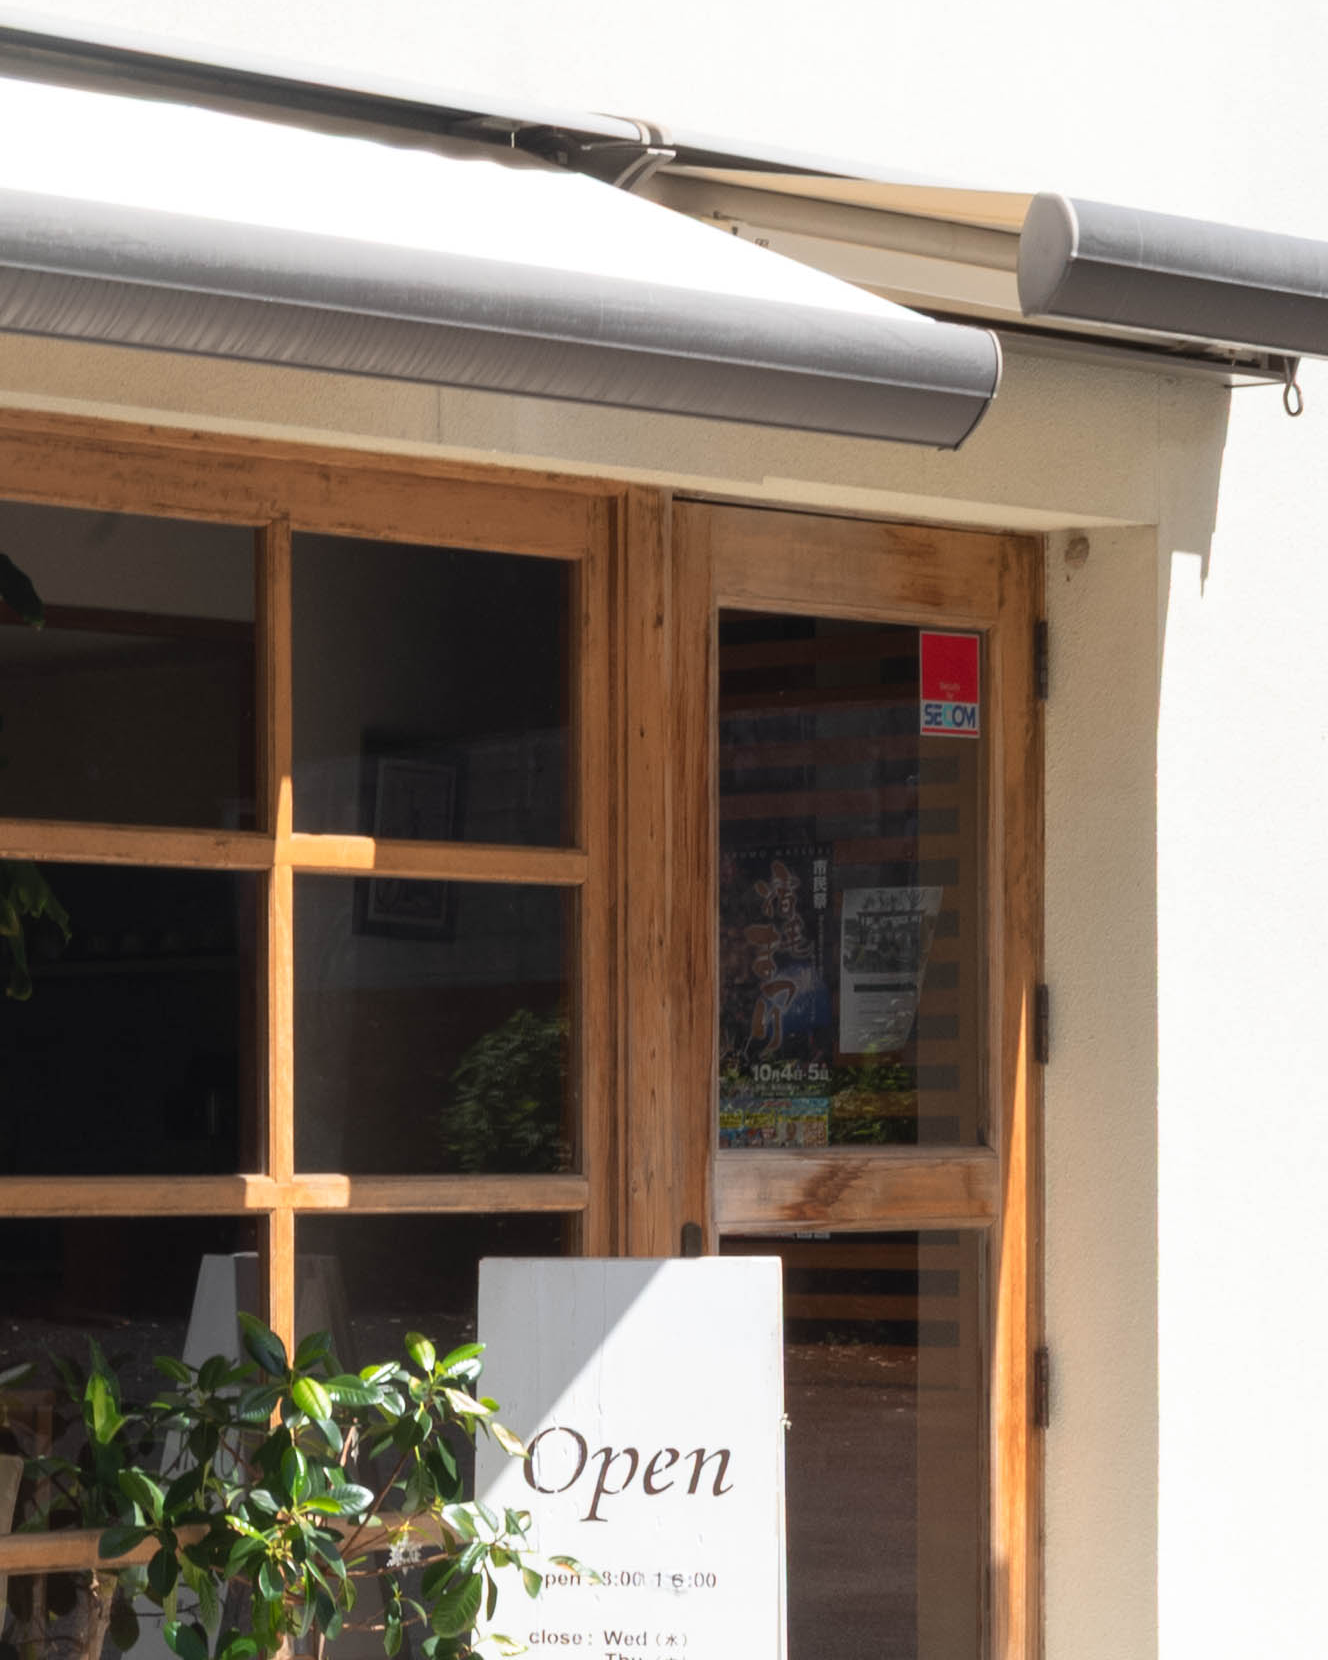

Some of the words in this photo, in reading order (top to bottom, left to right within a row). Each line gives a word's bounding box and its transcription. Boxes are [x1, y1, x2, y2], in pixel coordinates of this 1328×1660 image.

[924, 703, 976, 728] SECOM
[522, 1425, 735, 1523] Open
[603, 1629, 648, 1647] Wed
